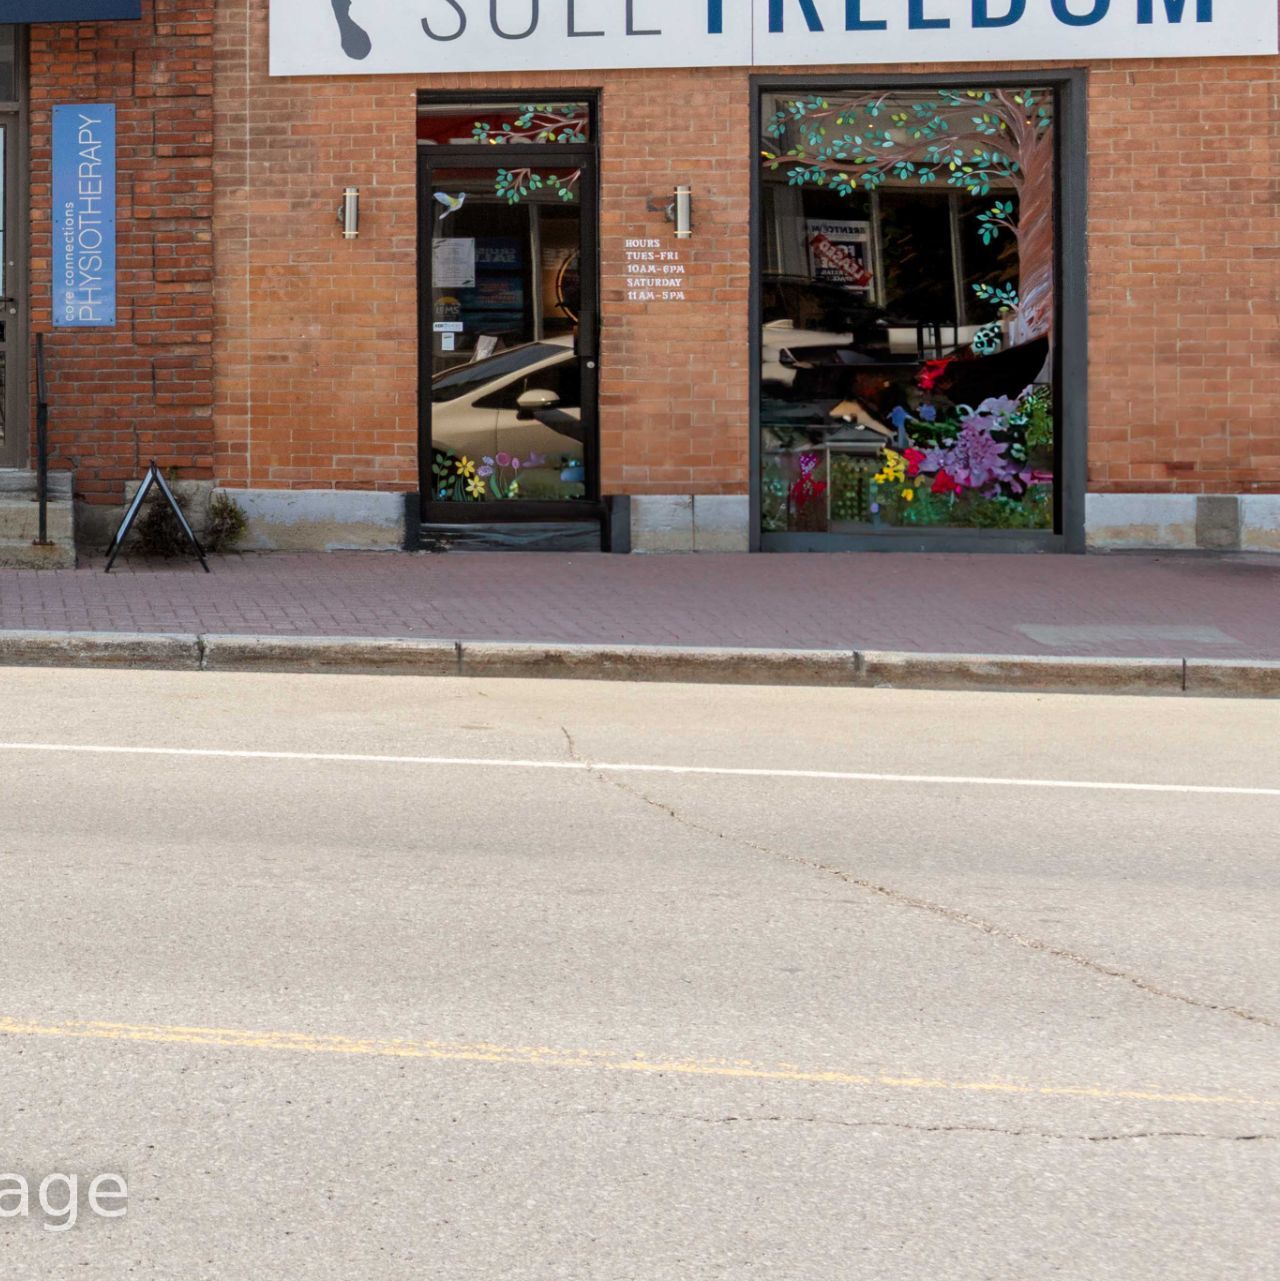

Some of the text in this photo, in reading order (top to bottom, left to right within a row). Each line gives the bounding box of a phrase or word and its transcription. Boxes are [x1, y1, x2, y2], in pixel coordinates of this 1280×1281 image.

[78, 113, 102, 322] PHYSIOTHERAPY
[625, 239, 660, 248] HOURS
[626, 251, 679, 260] TUES-FRI
[62, 202, 74, 321] core connections
[627, 278, 682, 287] SATURDAY
